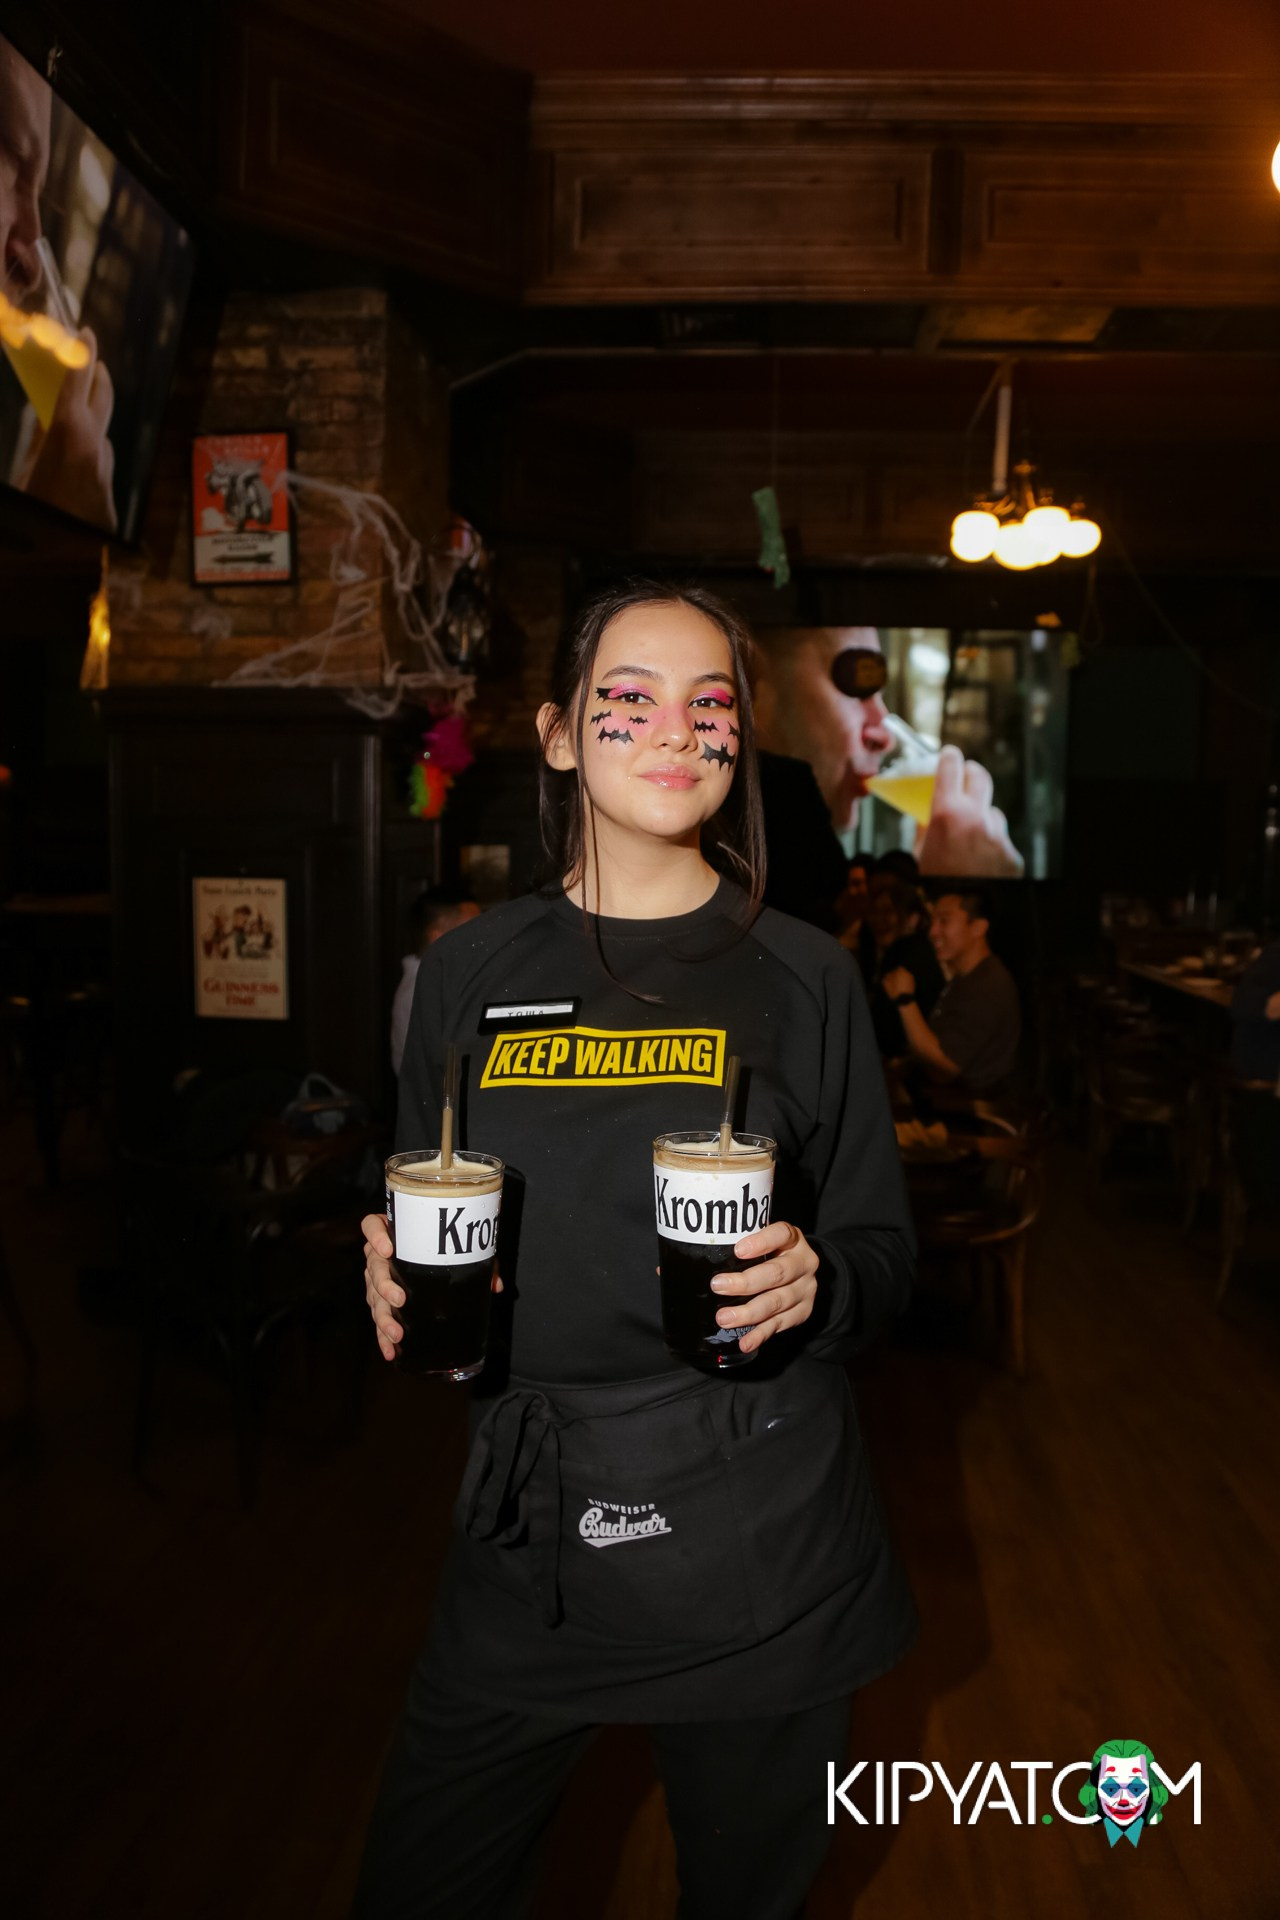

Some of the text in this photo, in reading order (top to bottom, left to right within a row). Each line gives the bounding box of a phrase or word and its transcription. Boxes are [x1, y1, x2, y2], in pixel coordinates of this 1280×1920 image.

[492, 1036, 713, 1076] KEEP WALKING
[655, 1174, 770, 1234] Kromba
[578, 1506, 673, 1546] Budvar
[587, 1497, 656, 1515] BUDWEISER
